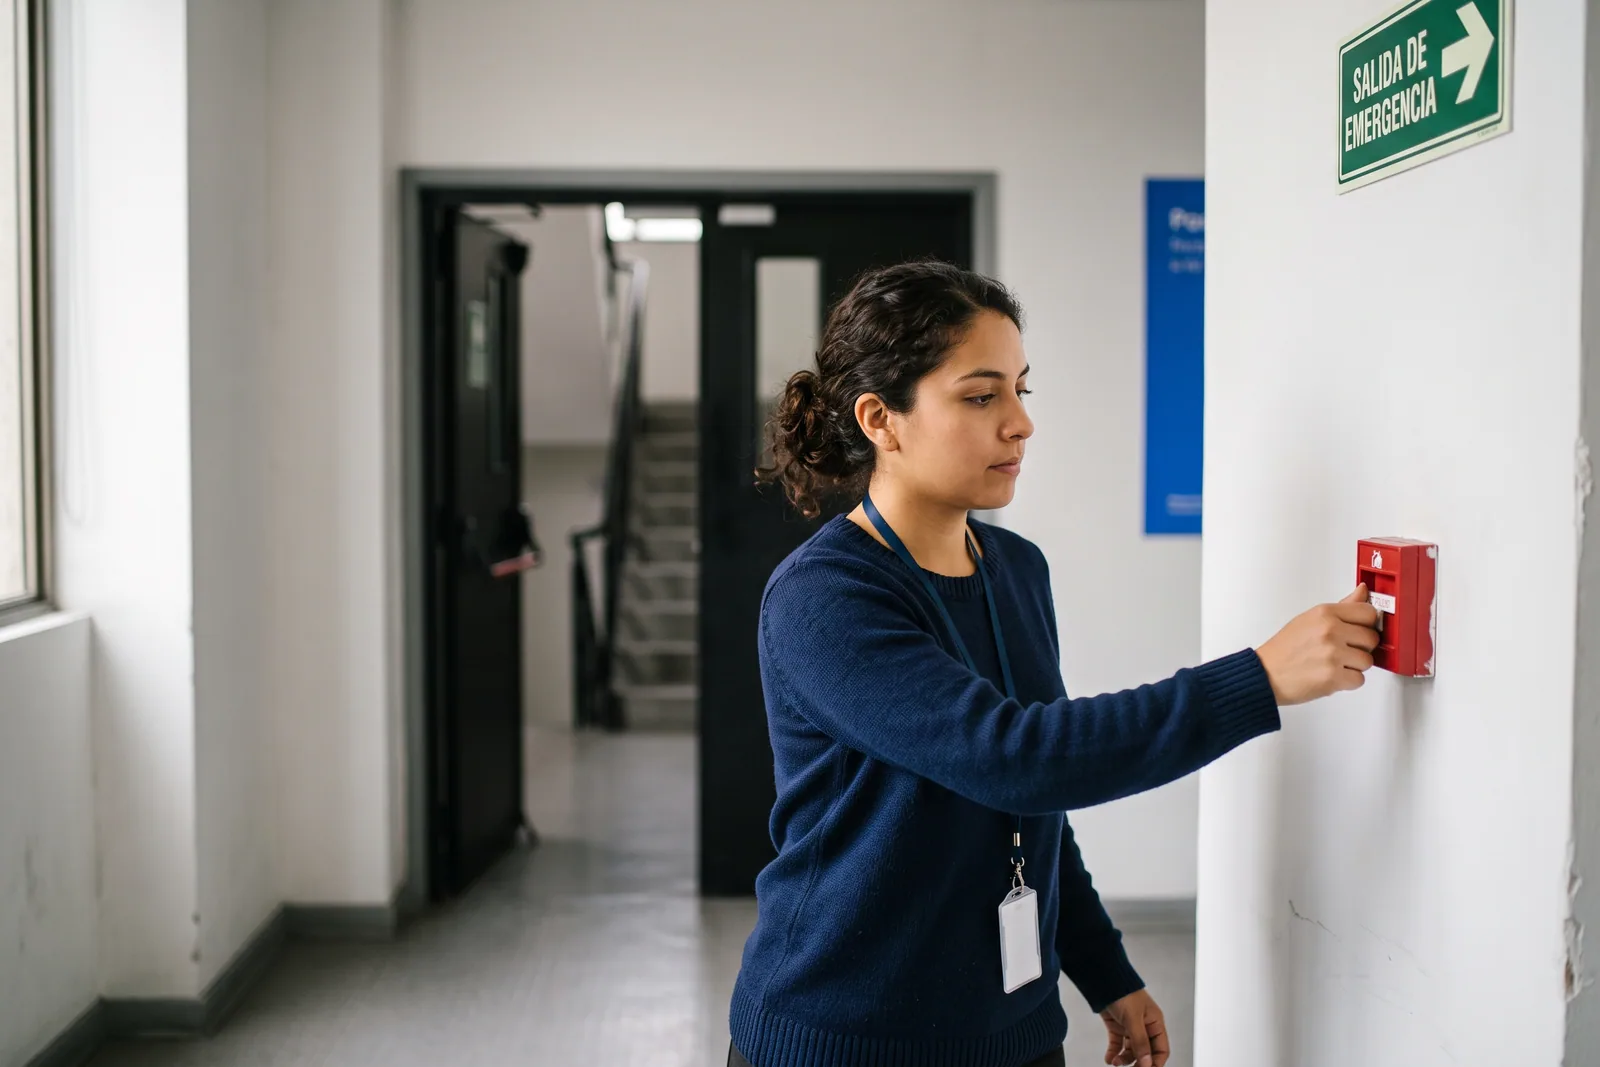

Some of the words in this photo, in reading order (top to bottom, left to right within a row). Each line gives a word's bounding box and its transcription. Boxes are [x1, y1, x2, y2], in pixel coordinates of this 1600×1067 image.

[1353, 44, 1403, 104] SALIDA
[1407, 29, 1427, 76] DE
[1345, 76, 1437, 152] EMERGENCIA
